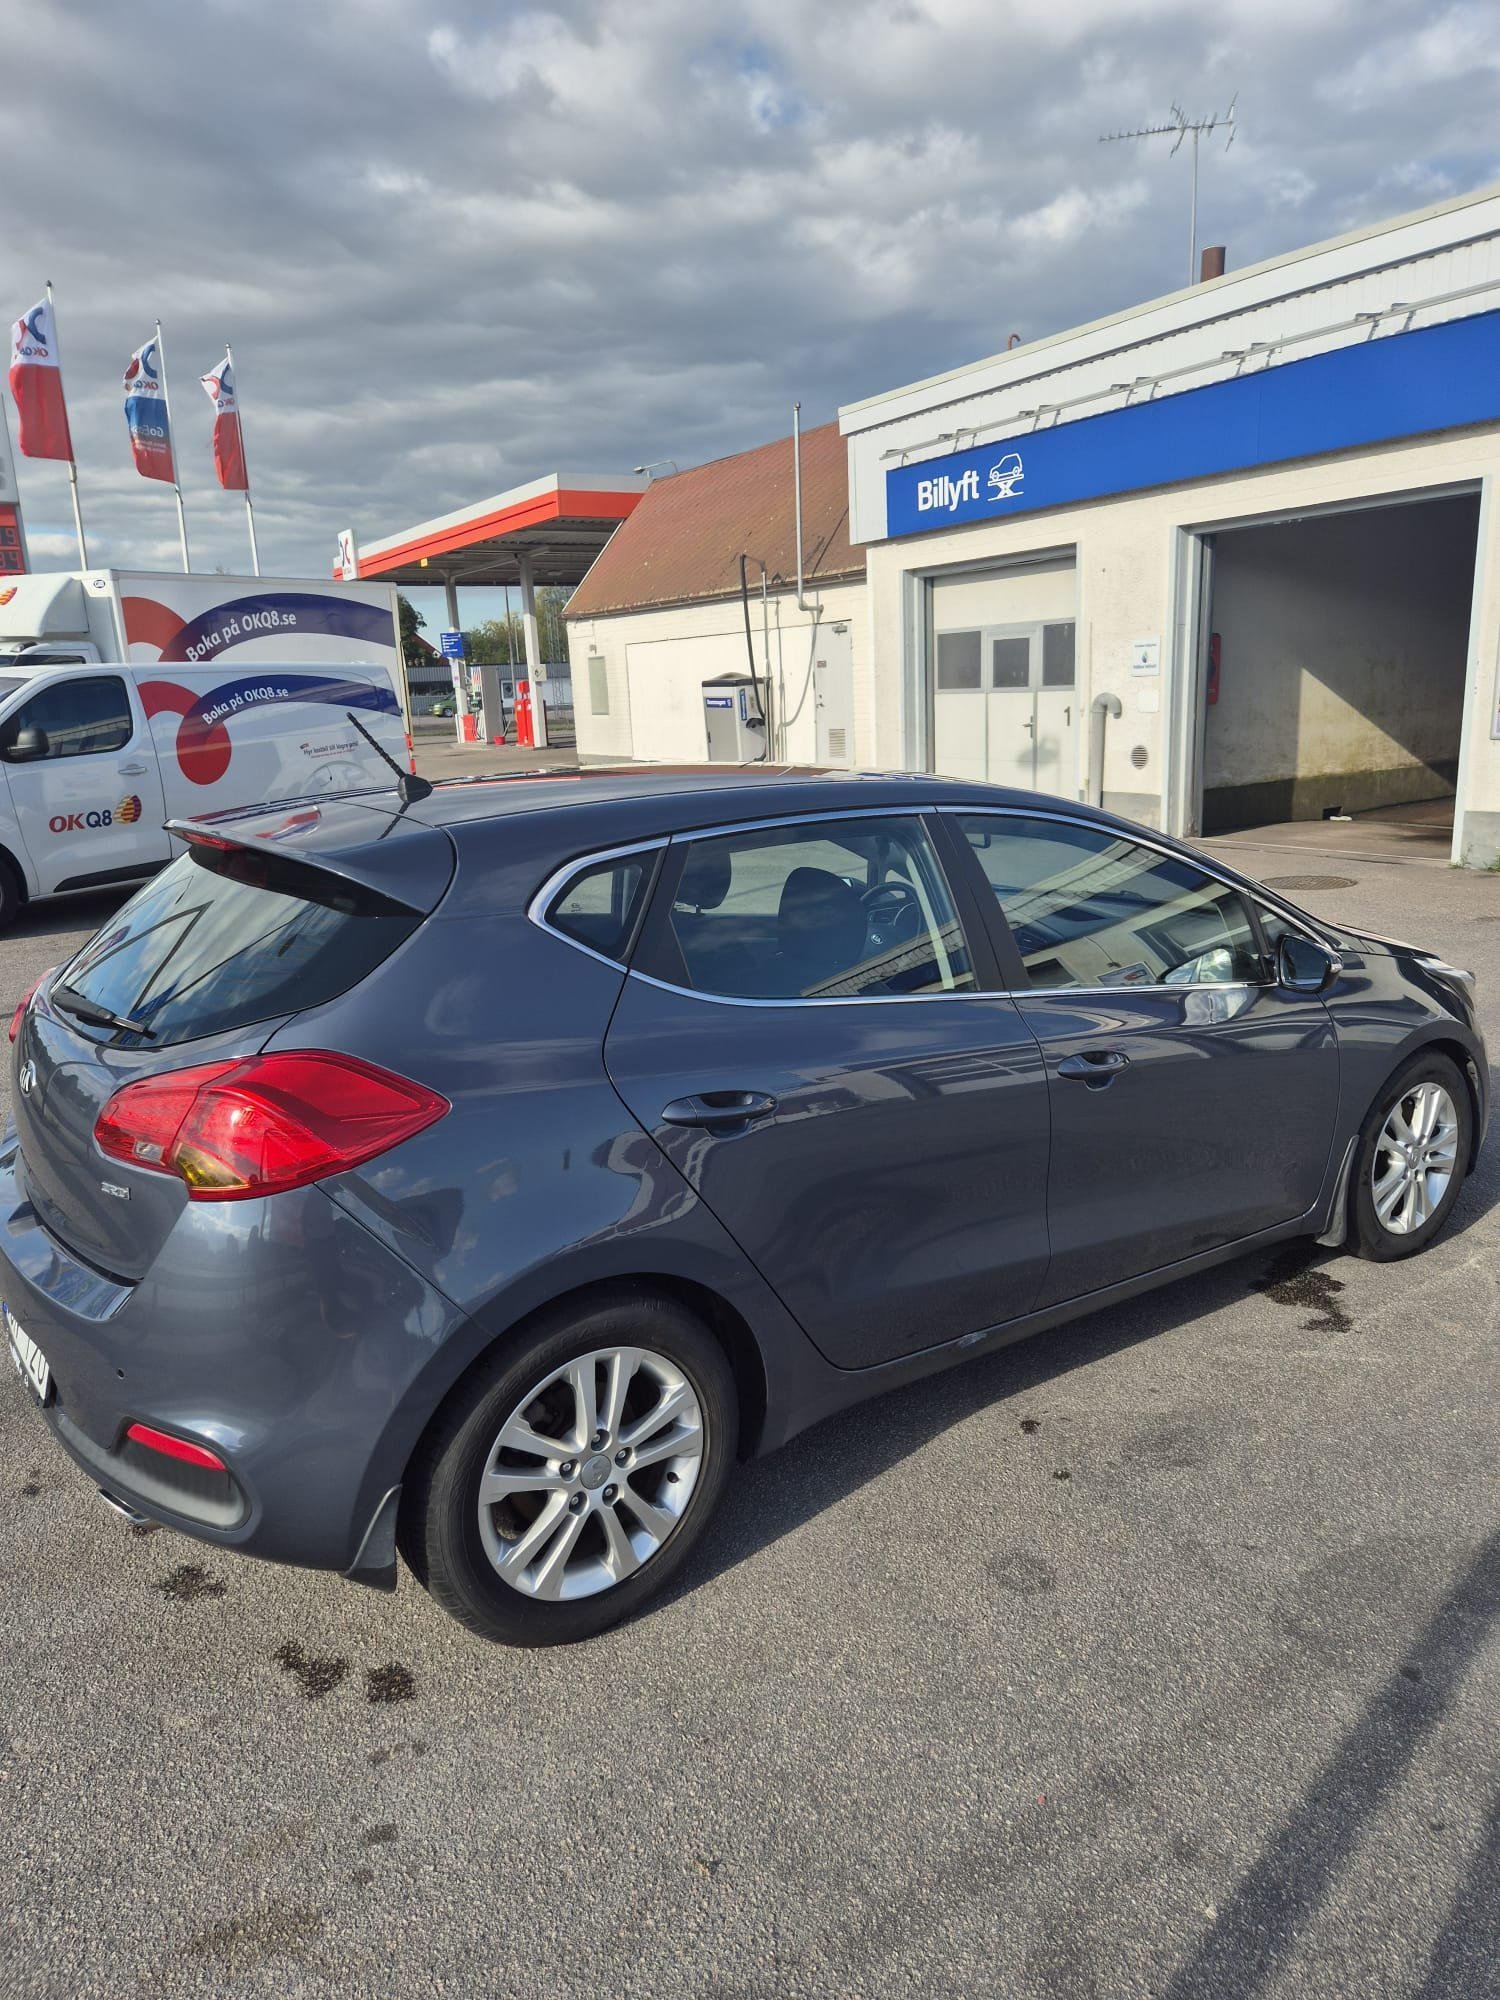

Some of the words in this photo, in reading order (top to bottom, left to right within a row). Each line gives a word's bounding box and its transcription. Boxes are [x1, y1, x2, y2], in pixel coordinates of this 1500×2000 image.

[917, 470, 980, 512] Billyft
[185, 634, 222, 662] Boka
[222, 619, 241, 643] på
[242, 610, 297, 633] OKQ8.se
[202, 704, 229, 725] Boka
[229, 693, 244, 710] på
[244, 686, 288, 702] OKQ8.se
